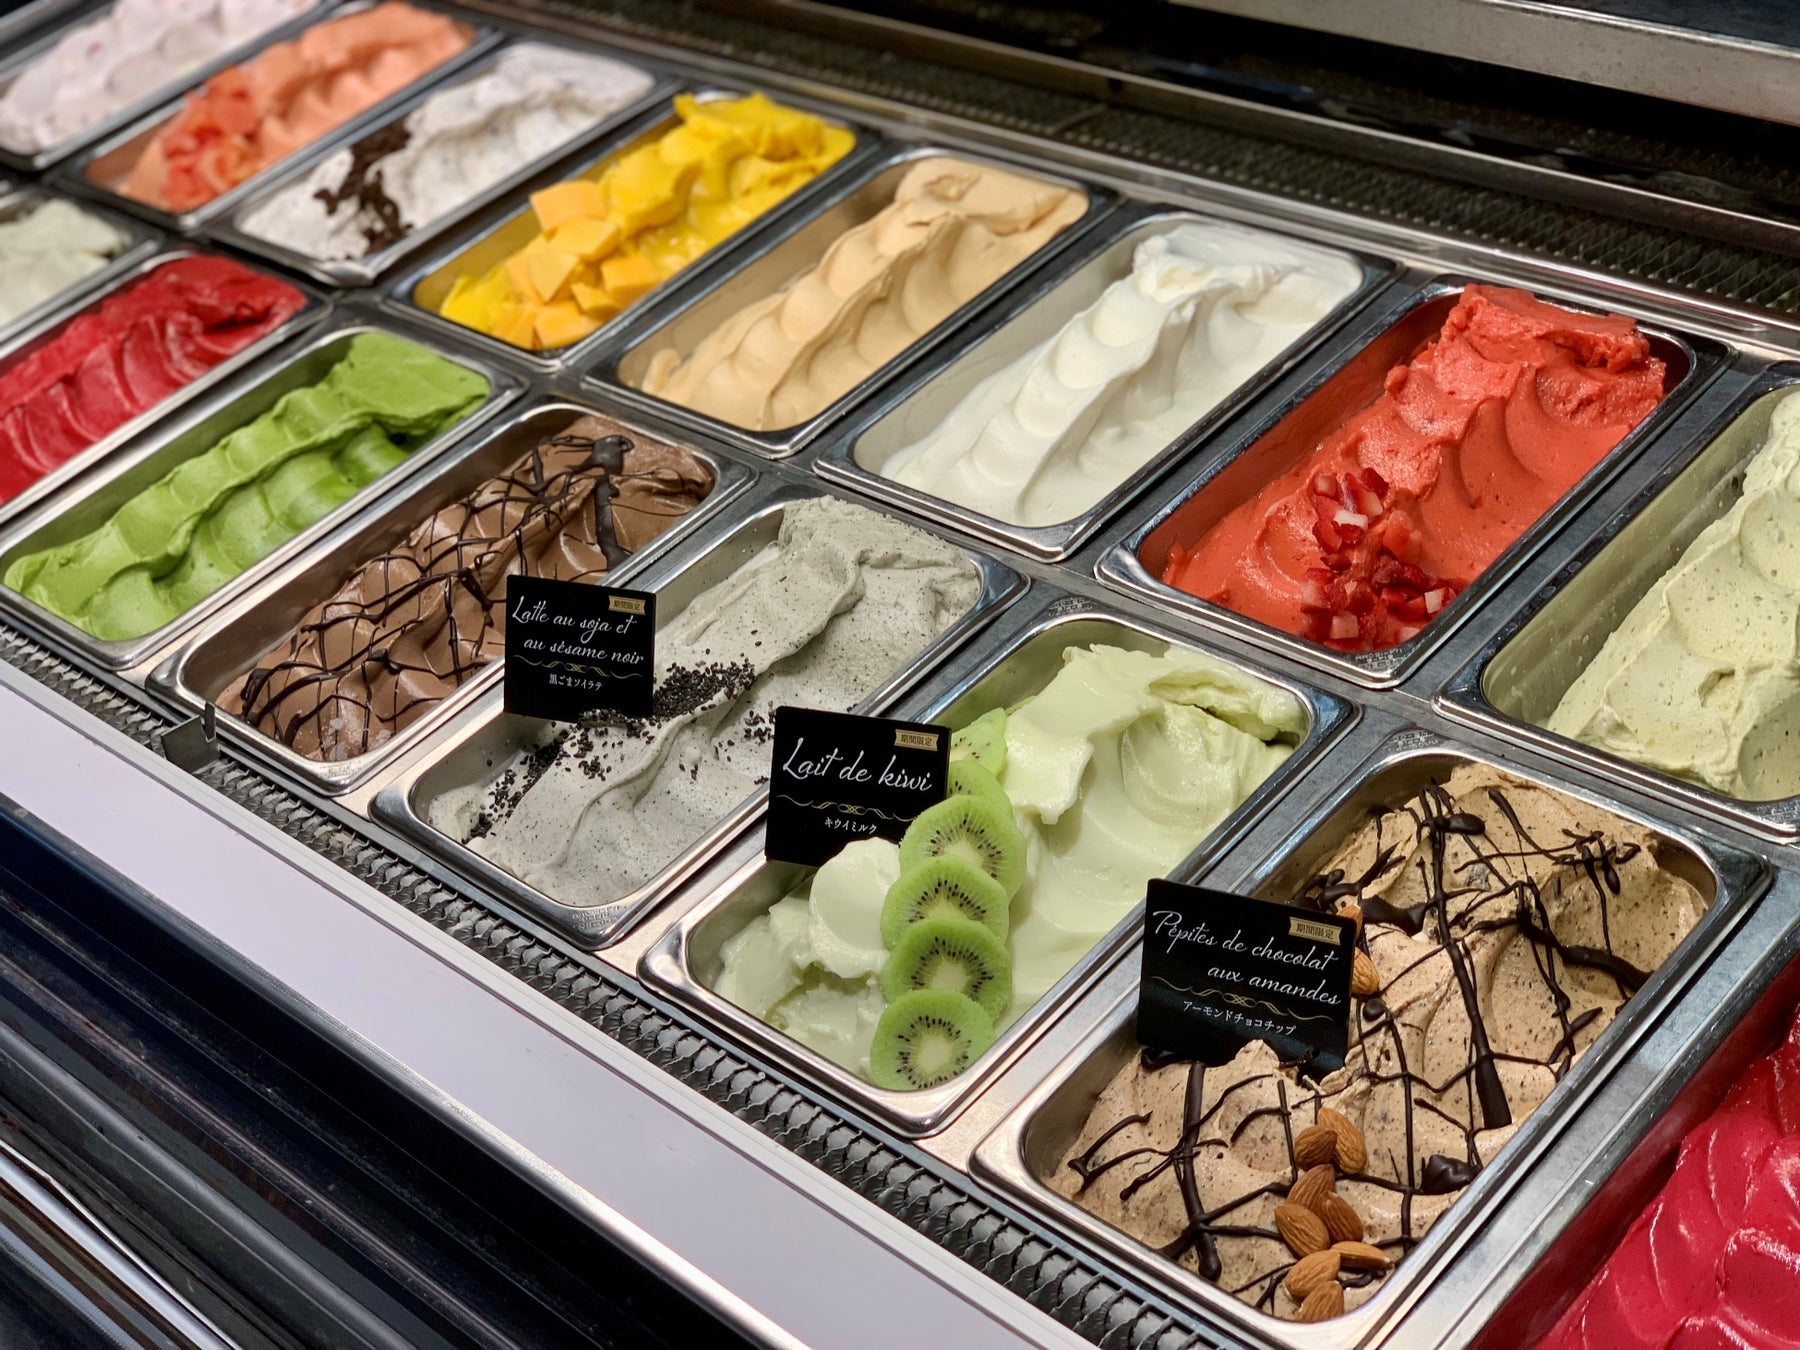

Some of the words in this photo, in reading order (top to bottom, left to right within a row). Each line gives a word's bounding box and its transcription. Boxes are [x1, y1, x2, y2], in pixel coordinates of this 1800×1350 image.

[512, 596, 549, 623] Latte
[553, 615, 576, 626] au
[580, 618, 612, 643] soja
[616, 615, 637, 634] et
[524, 639, 546, 650] au
[550, 641, 607, 658] sésame
[611, 652, 644, 664] noir
[549, 673, 603, 690] 黒ごまソイラテ
[901, 734, 932, 746] 期間限定
[783, 738, 843, 779] Lait
[839, 750, 872, 781] de
[879, 755, 932, 791] kiwi
[825, 817, 877, 834] キウイミルク
[1153, 911, 1217, 953] Pépites
[1223, 929, 1247, 952] de
[1252, 937, 1338, 971] chocolat
[1296, 922, 1333, 939] 期間限定
[1208, 967, 1244, 982] aux
[1249, 980, 1341, 1005] amandes
[1183, 1001, 1296, 1035] アーモンドチョコチップ
